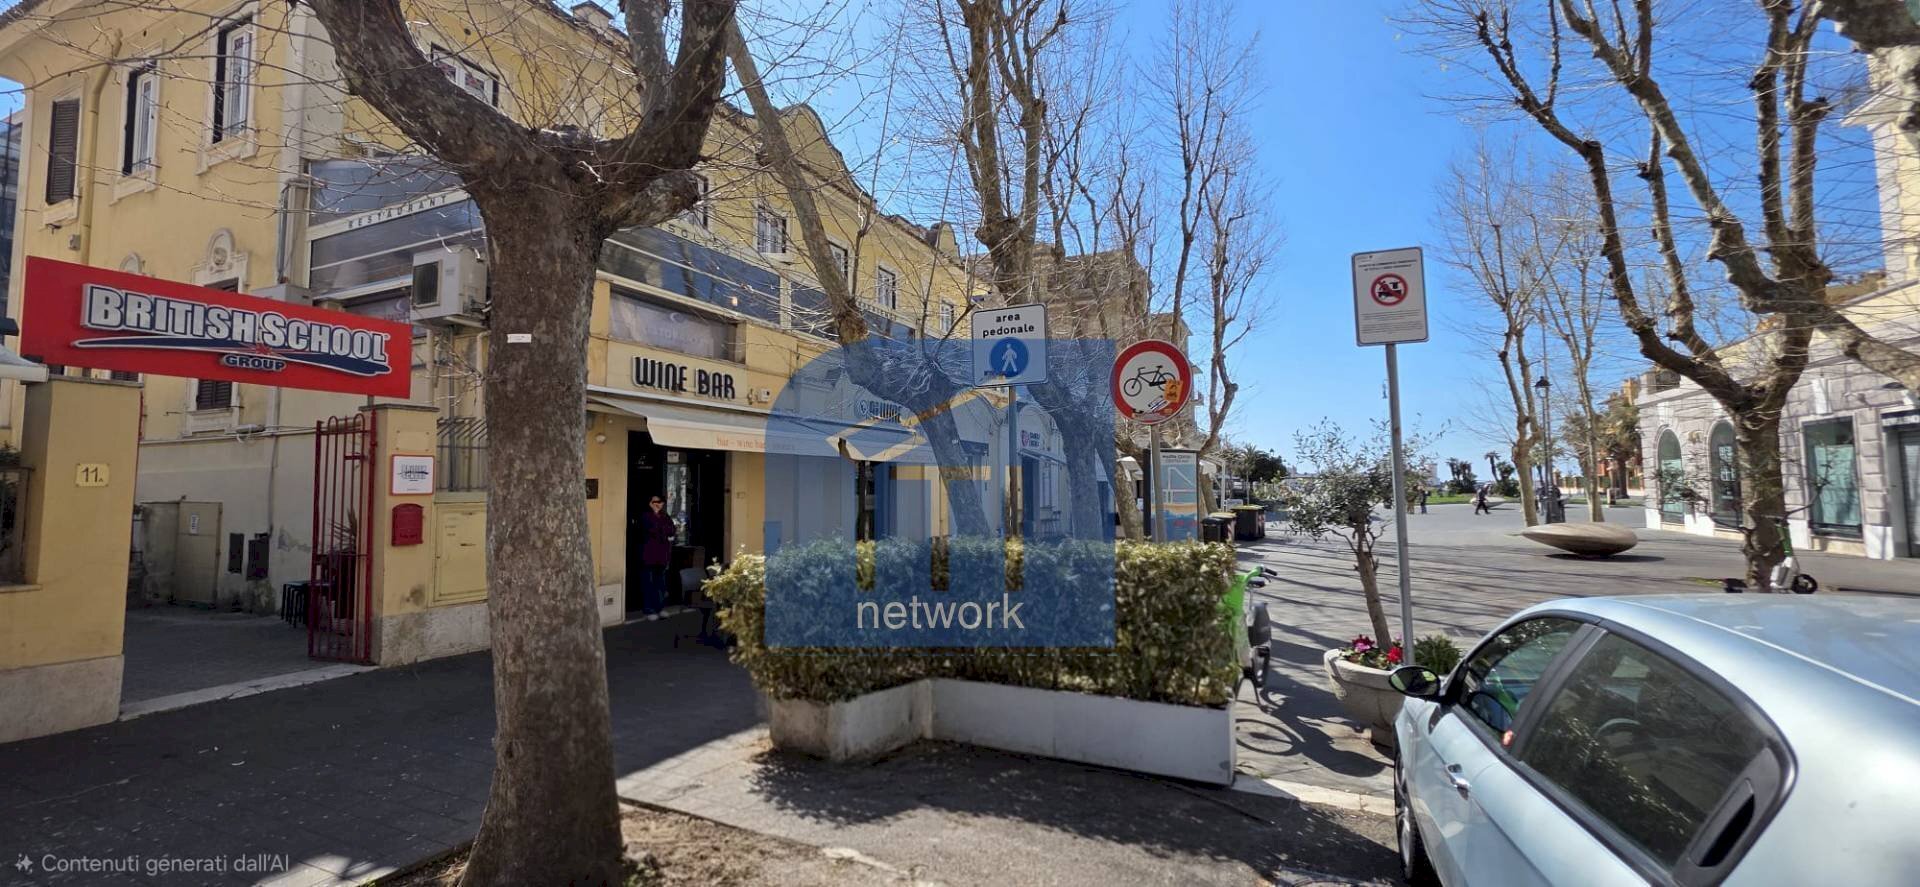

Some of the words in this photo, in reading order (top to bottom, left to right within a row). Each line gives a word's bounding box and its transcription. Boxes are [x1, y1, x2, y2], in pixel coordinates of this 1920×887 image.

[347, 194, 447, 229] RESTAURANT
[83, 283, 257, 344] BRITISH
[260, 311, 388, 362] SCHOOL
[982, 323, 1035, 338] pedonale
[995, 313, 1021, 323] area
[222, 354, 287, 372] GROUP
[633, 356, 688, 392] WINE
[696, 367, 736, 399] BAR
